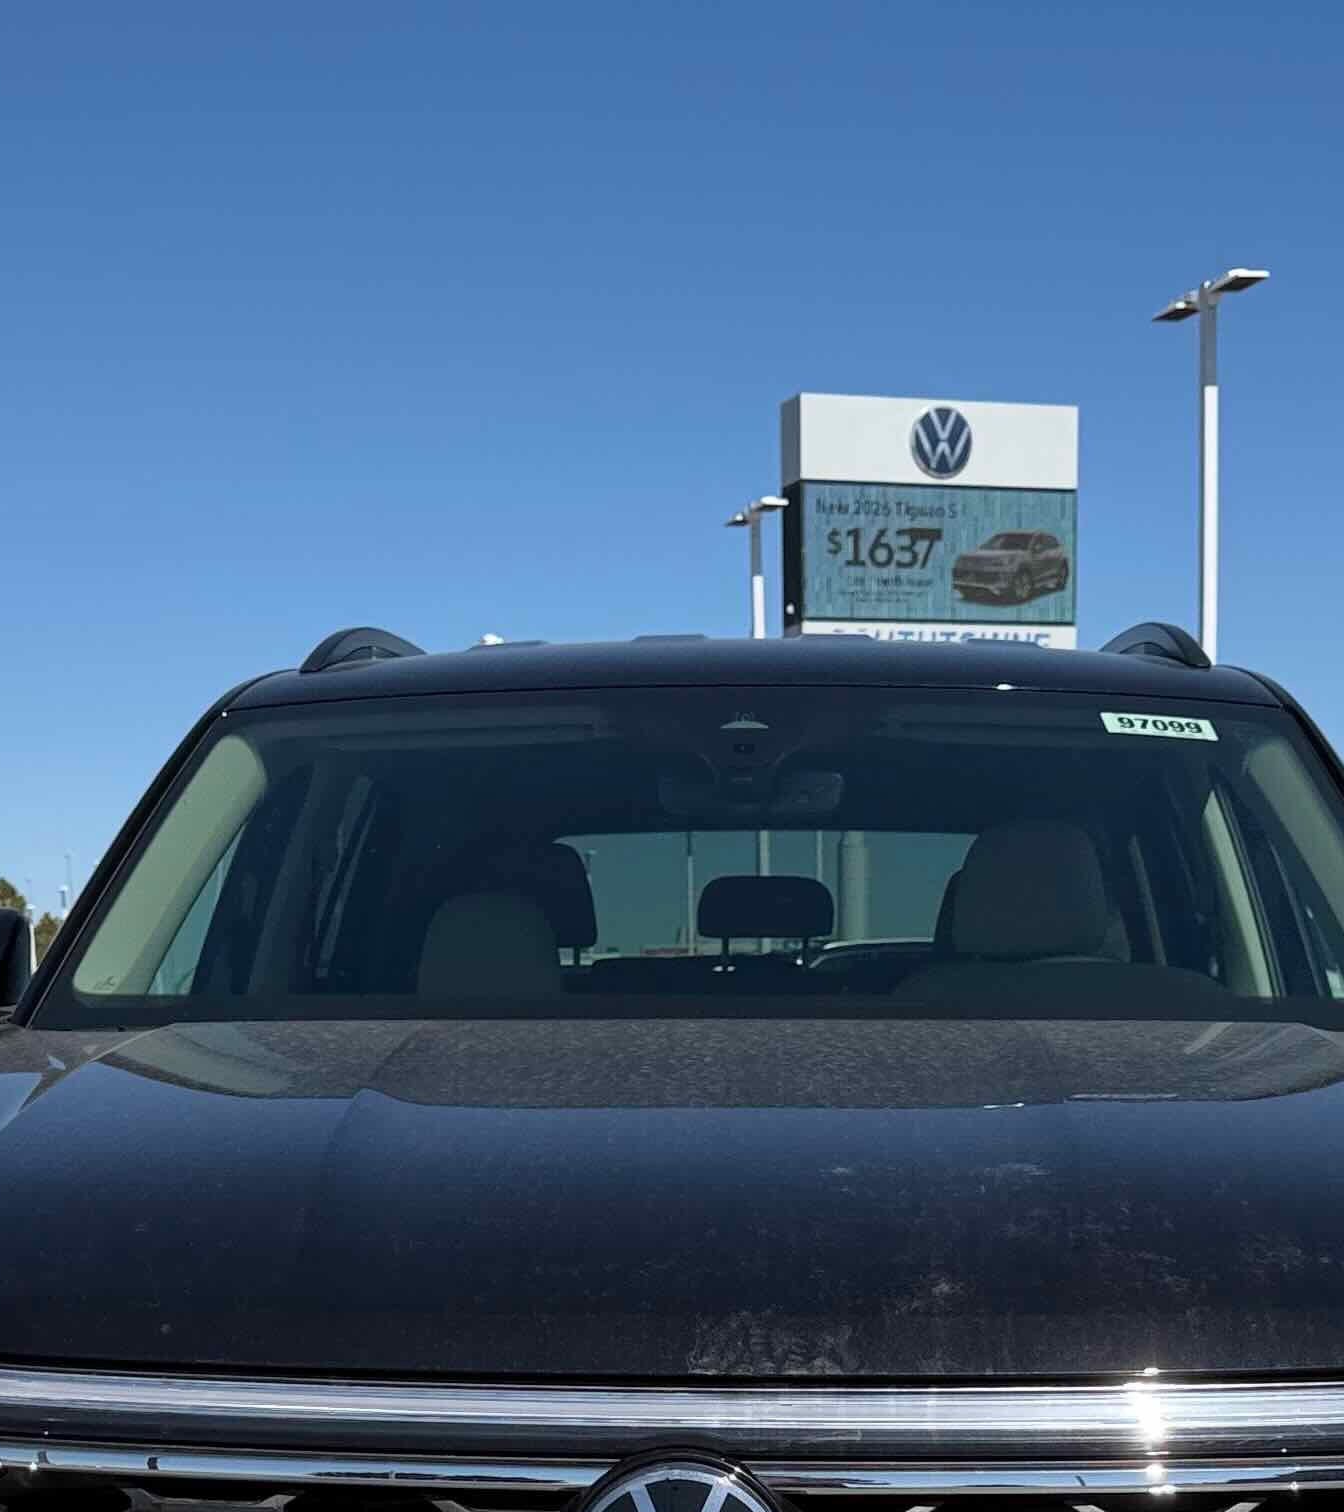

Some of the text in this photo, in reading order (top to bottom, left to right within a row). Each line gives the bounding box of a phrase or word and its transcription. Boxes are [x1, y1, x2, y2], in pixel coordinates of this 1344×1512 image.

[912, 408, 971, 478] VW
[826, 528, 943, 569] $1637
[1117, 717, 1202, 734] 97099
